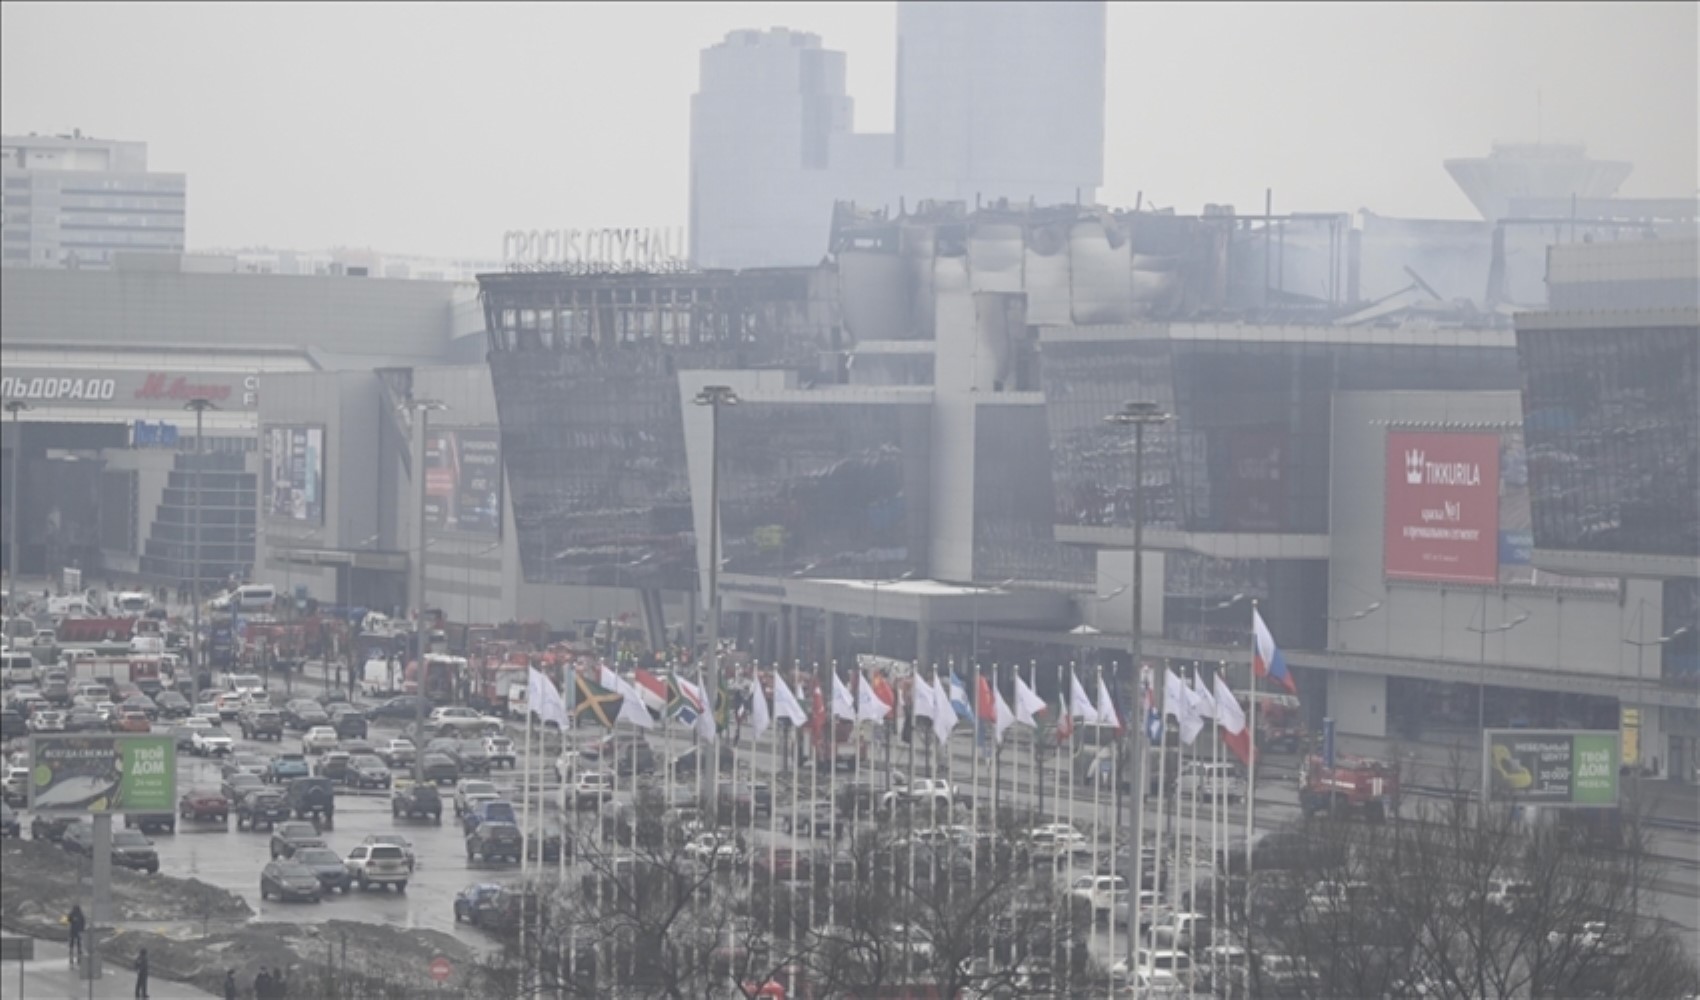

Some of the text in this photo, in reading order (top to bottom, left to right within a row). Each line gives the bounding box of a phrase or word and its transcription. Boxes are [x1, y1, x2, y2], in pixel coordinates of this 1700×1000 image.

[504, 227, 686, 261] CROCUS CITY HALL
[1425, 462, 1480, 486] TIKKURILA
[134, 745, 164, 760] ТВОЙ
[1580, 748, 1609, 762] ТВОЙ
[131, 761, 164, 776] ДОМ
[1577, 762, 1609, 776] ДОМ
